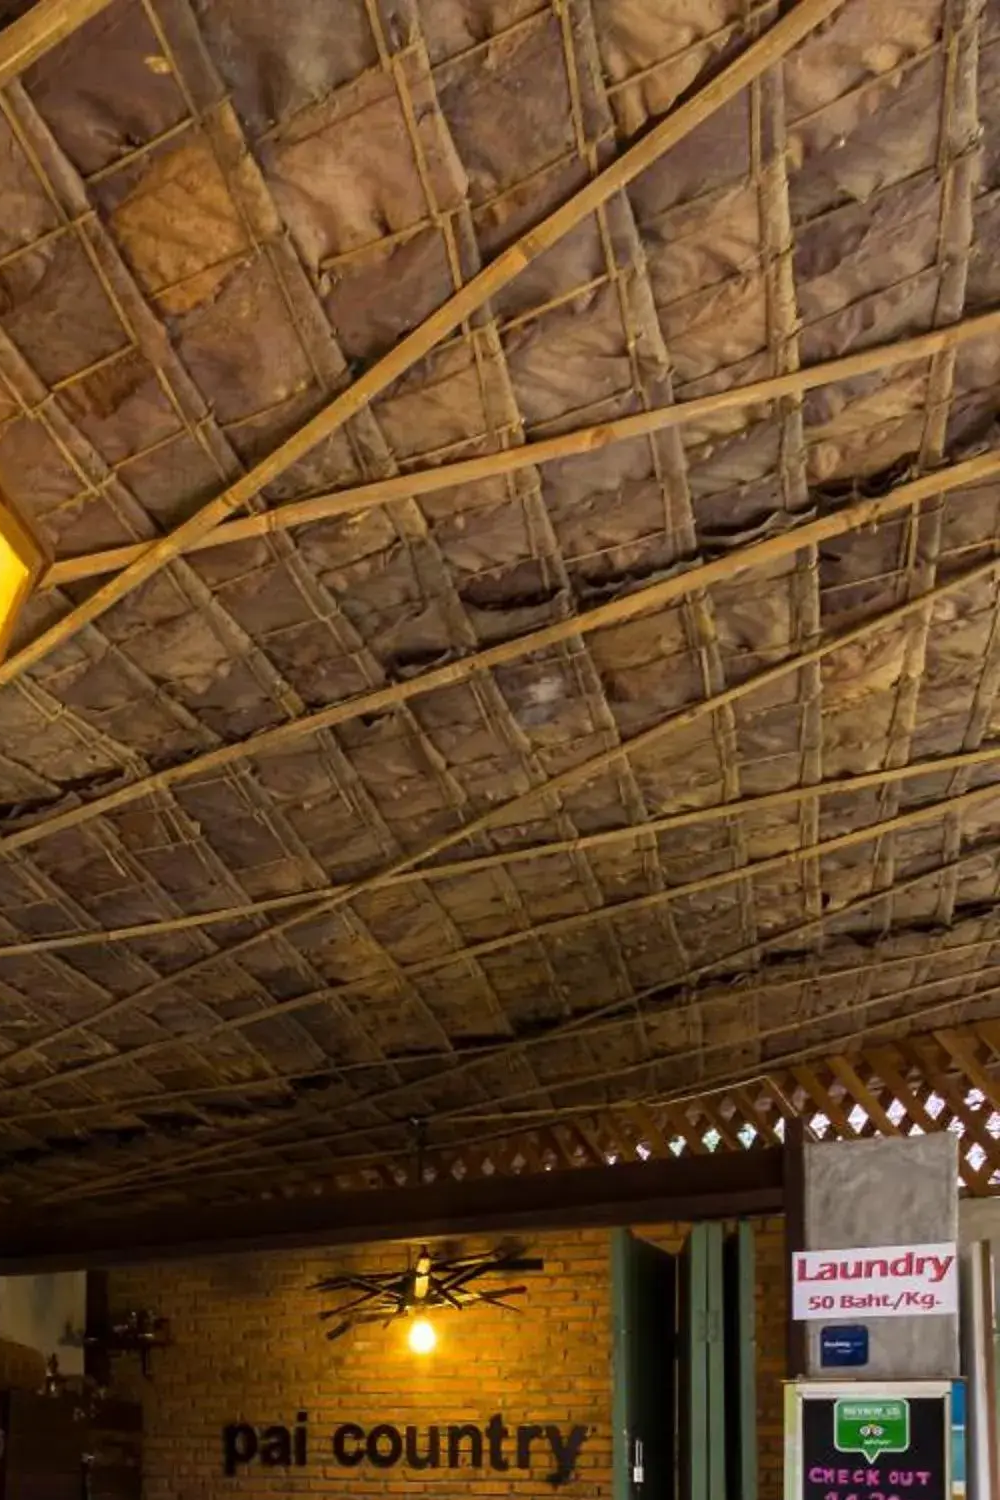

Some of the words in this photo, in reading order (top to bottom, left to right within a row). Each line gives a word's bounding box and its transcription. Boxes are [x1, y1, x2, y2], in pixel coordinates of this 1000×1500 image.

[797, 1251, 955, 1283] Laundry
[808, 1295, 835, 1311] 50
[222, 1411, 308, 1476] pai
[333, 1413, 589, 1487] country
[808, 1467, 880, 1487] CHECK
[887, 1470, 932, 1487] OUT
